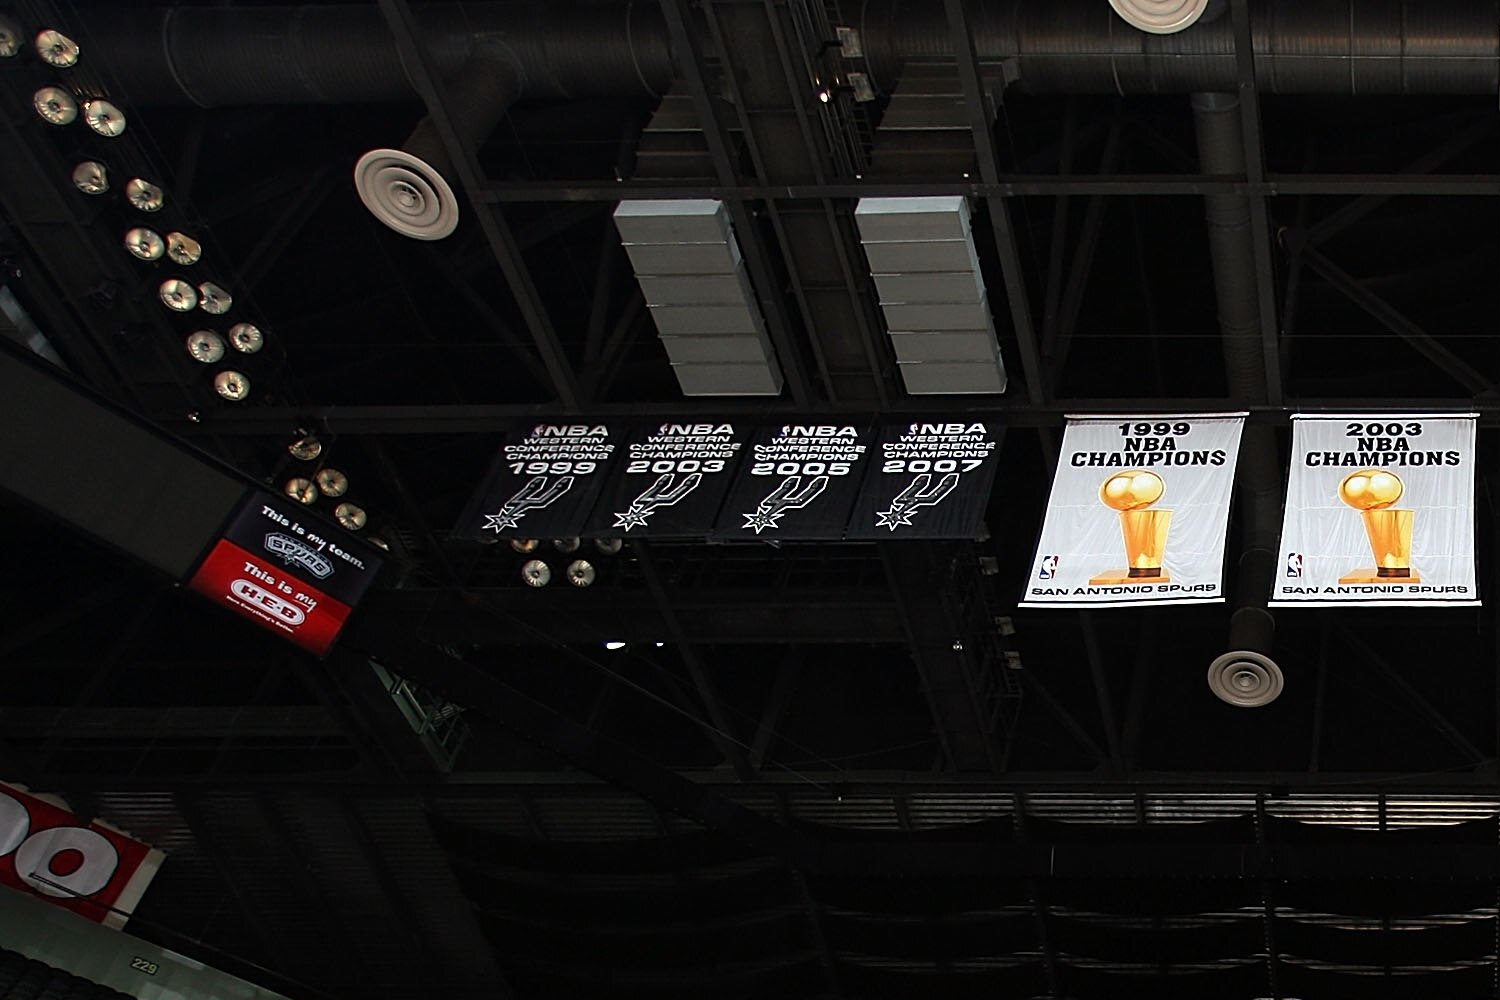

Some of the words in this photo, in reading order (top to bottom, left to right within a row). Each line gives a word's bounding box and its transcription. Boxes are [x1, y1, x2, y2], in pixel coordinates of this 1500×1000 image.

[544, 425, 609, 436] NBA
[668, 424, 734, 435] NBA
[791, 426, 858, 437] NBA
[919, 423, 987, 435] NBA
[1118, 422, 1191, 436] 1999
[1346, 423, 1422, 436] 2003
[523, 437, 605, 445] WESTERN
[629, 443, 742, 451] CONFERENCE
[882, 442, 995, 450] CONFERENCE
[1124, 437, 1177, 451] NBA
[1357, 437, 1410, 451] NBA
[504, 445, 615, 453] CONFERENCE
[629, 451, 733, 459] CHAMPIONS
[754, 445, 866, 453] CONFERENCE
[884, 450, 989, 458] CHAMPIONS
[506, 452, 609, 460] CHAMPIONS
[754, 453, 859, 461] CHAMPIONS
[1071, 450, 1226, 467] CHAMPIONS
[1305, 451, 1460, 466] CHAMPIONS
[508, 462, 597, 475] 1999
[626, 460, 726, 473] 2003
[751, 462, 851, 475] 2005
[882, 460, 983, 473] 2007
[262, 505, 289, 527] This
[291, 522, 305, 535] is
[307, 533, 326, 551] my
[329, 544, 365, 570] team.
[272, 539, 326, 572] SPURS
[243, 562, 275, 585] This
[277, 581, 293, 595] is
[295, 593, 317, 613] my
[1031, 588, 1069, 596] SAN
[1072, 586, 1153, 595] ANTONIO
[1157, 584, 1216, 592] SPURS
[1282, 586, 1319, 594] SAN
[1323, 586, 1404, 594] ANTONIO
[0, 792, 118, 898] O
[131, 957, 158, 974] 229
